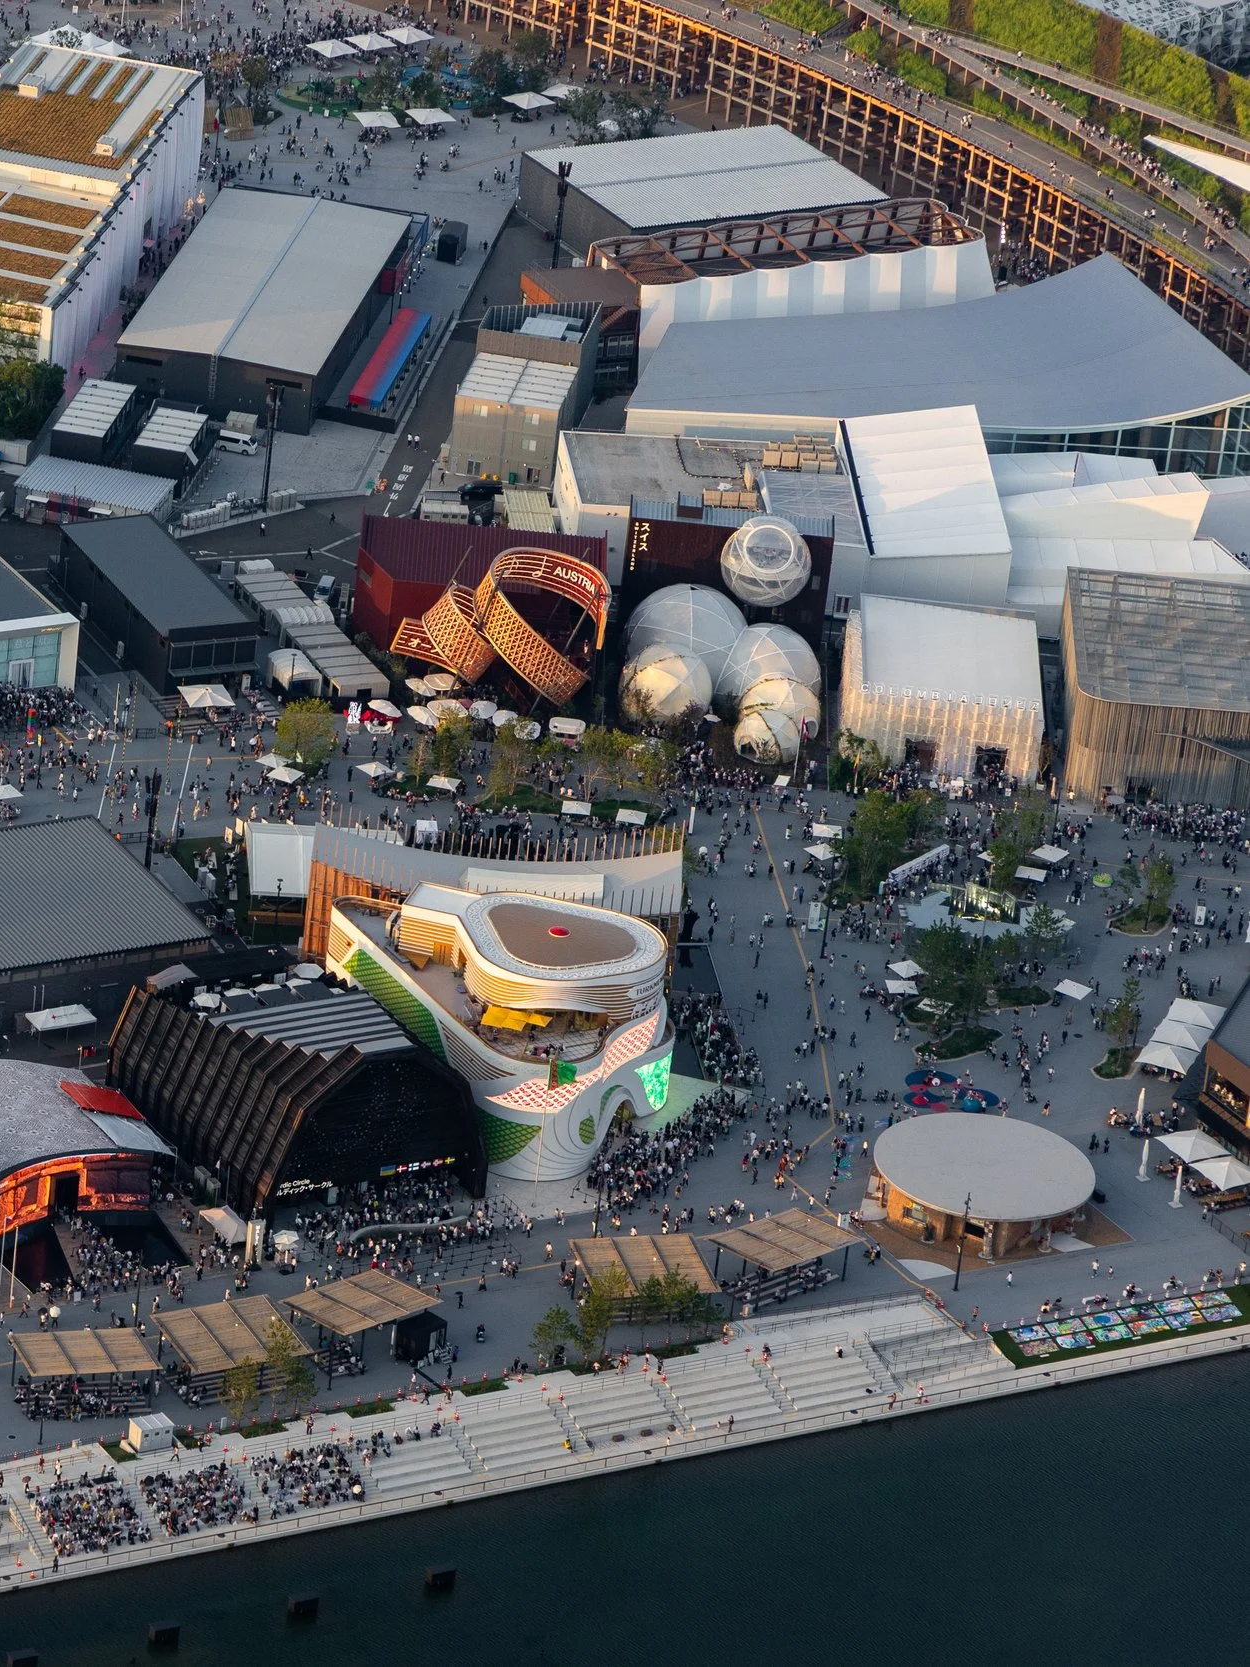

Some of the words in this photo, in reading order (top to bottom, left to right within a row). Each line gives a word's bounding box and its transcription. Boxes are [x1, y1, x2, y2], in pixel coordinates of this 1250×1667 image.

[630, 521, 639, 570] SWITZERLAND
[639, 522, 650, 551] スイス
[553, 566, 595, 595] AUSTRIA
[861, 682, 968, 703] COLOMBIA
[292, 1179, 310, 1187] Circle
